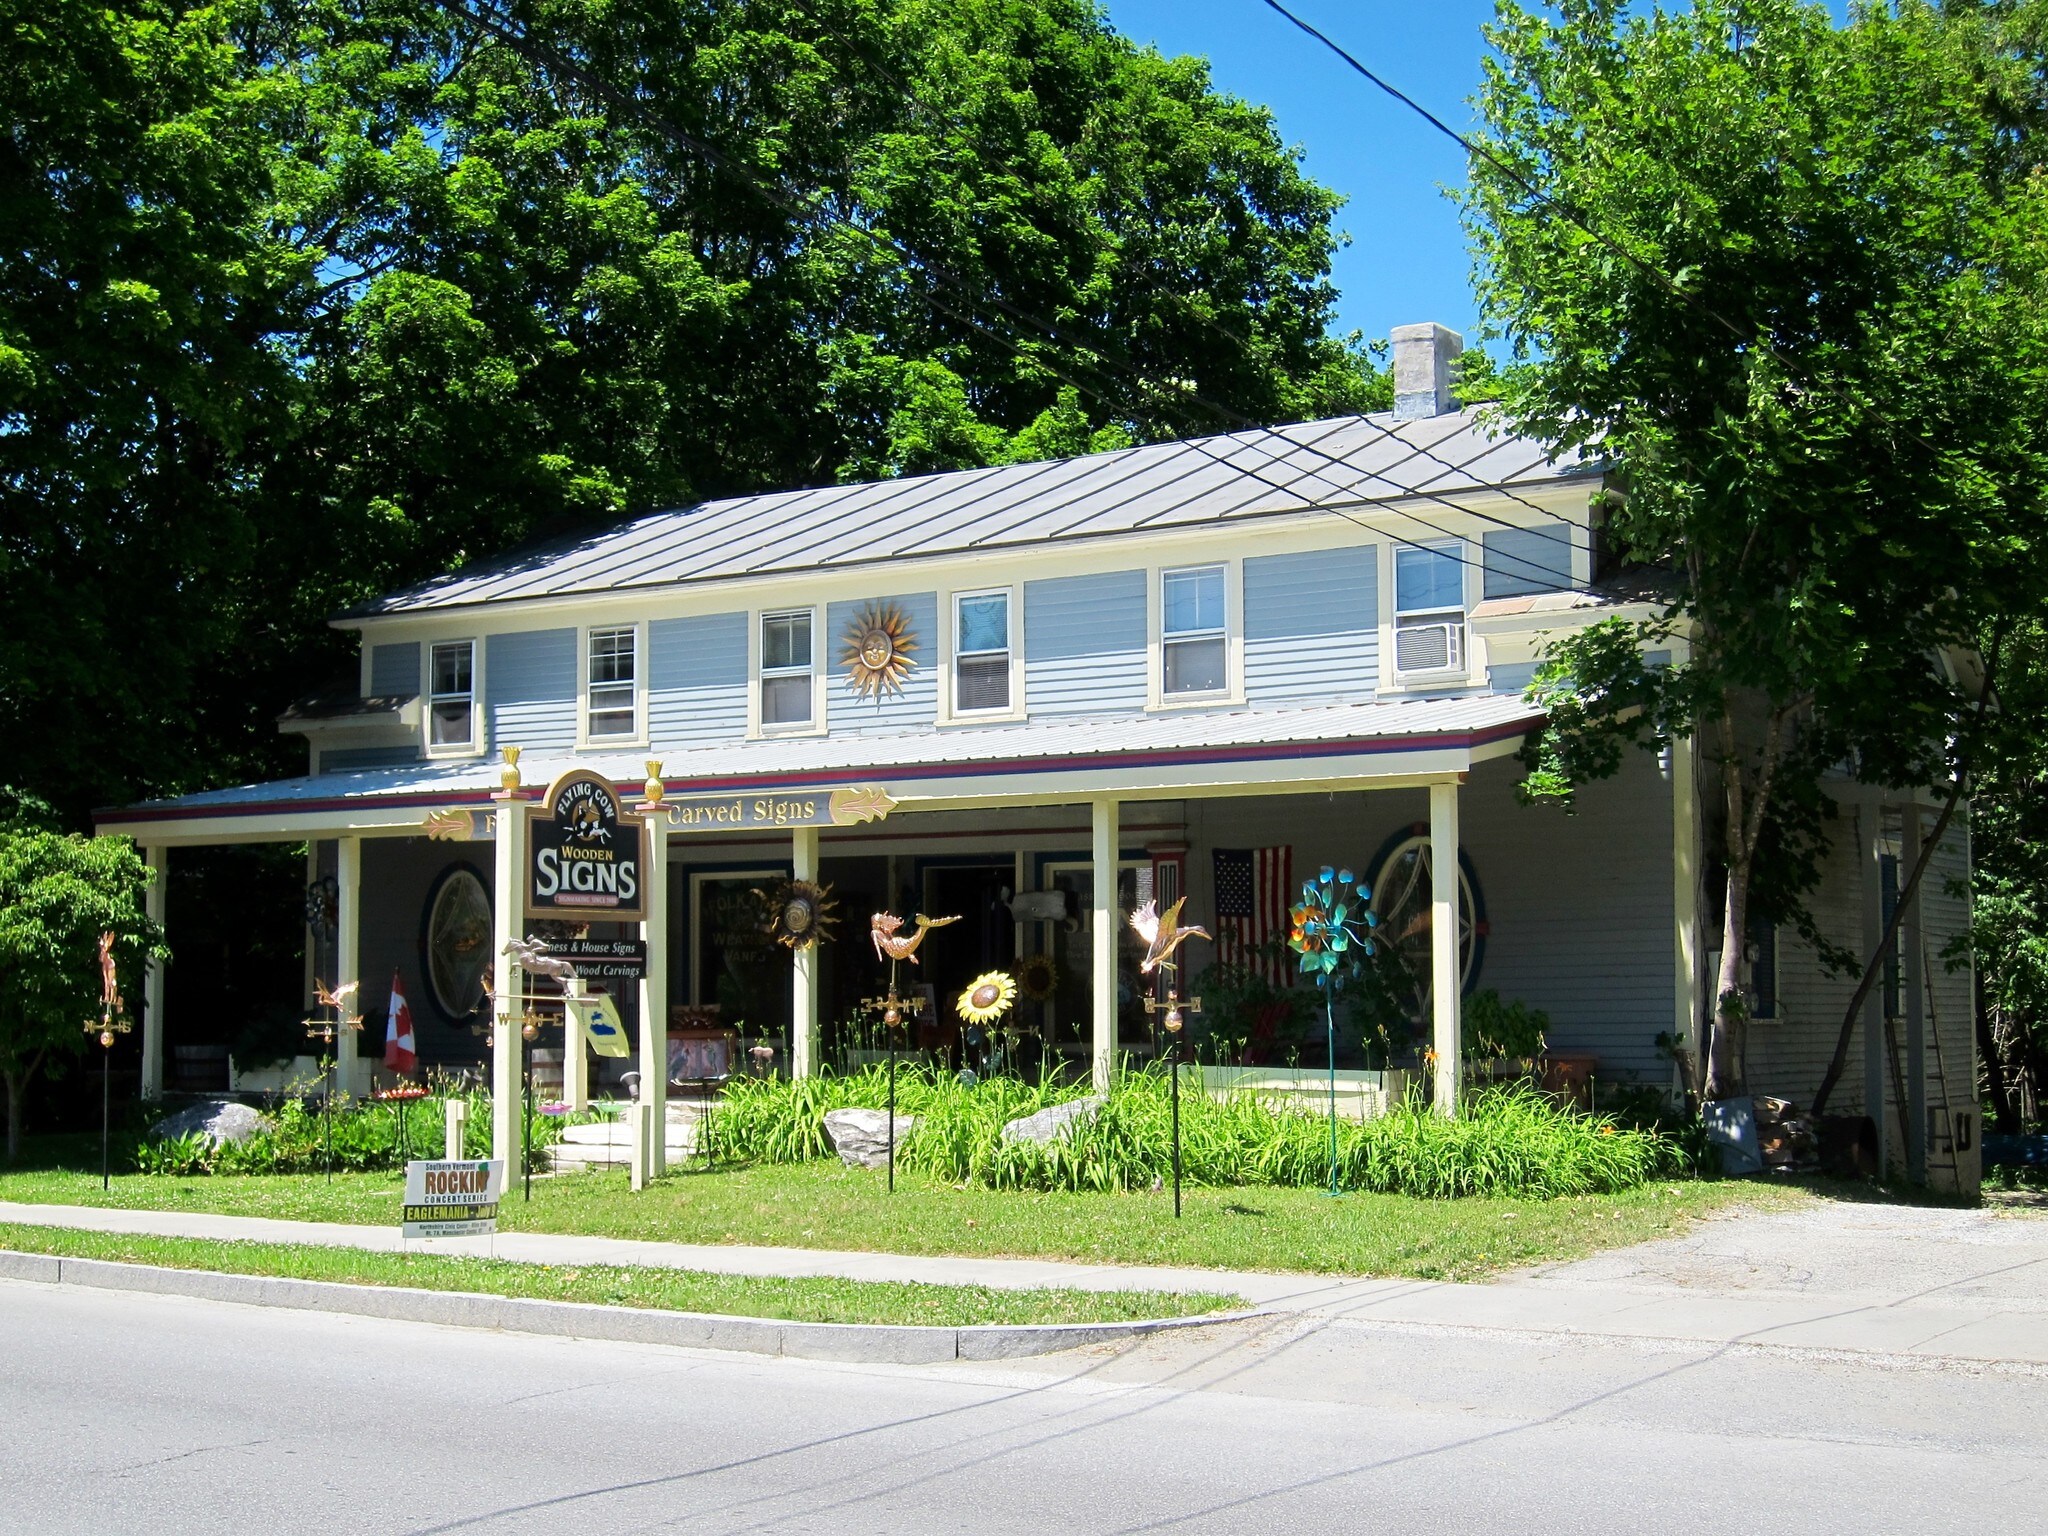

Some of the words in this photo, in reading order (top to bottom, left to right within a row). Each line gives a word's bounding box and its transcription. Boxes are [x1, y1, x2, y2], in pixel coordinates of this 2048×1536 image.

[557, 783, 591, 815] FLYING
[594, 789, 615, 819] COW
[667, 800, 742, 825] Carved
[753, 798, 816, 825] Signs
[561, 845, 613, 861] WOODEN
[536, 848, 636, 900] SIGNS
[570, 942, 579, 953] &
[581, 941, 610, 953] House
[611, 943, 636, 956] Signs
[576, 964, 601, 974] Wood
[603, 964, 640, 978] Carvings
[426, 1163, 451, 1171] Southern
[424, 1195, 461, 1204] CONCERT
[463, 1194, 488, 1203] SERIES
[407, 1206, 469, 1221] EAGLEMANIA
